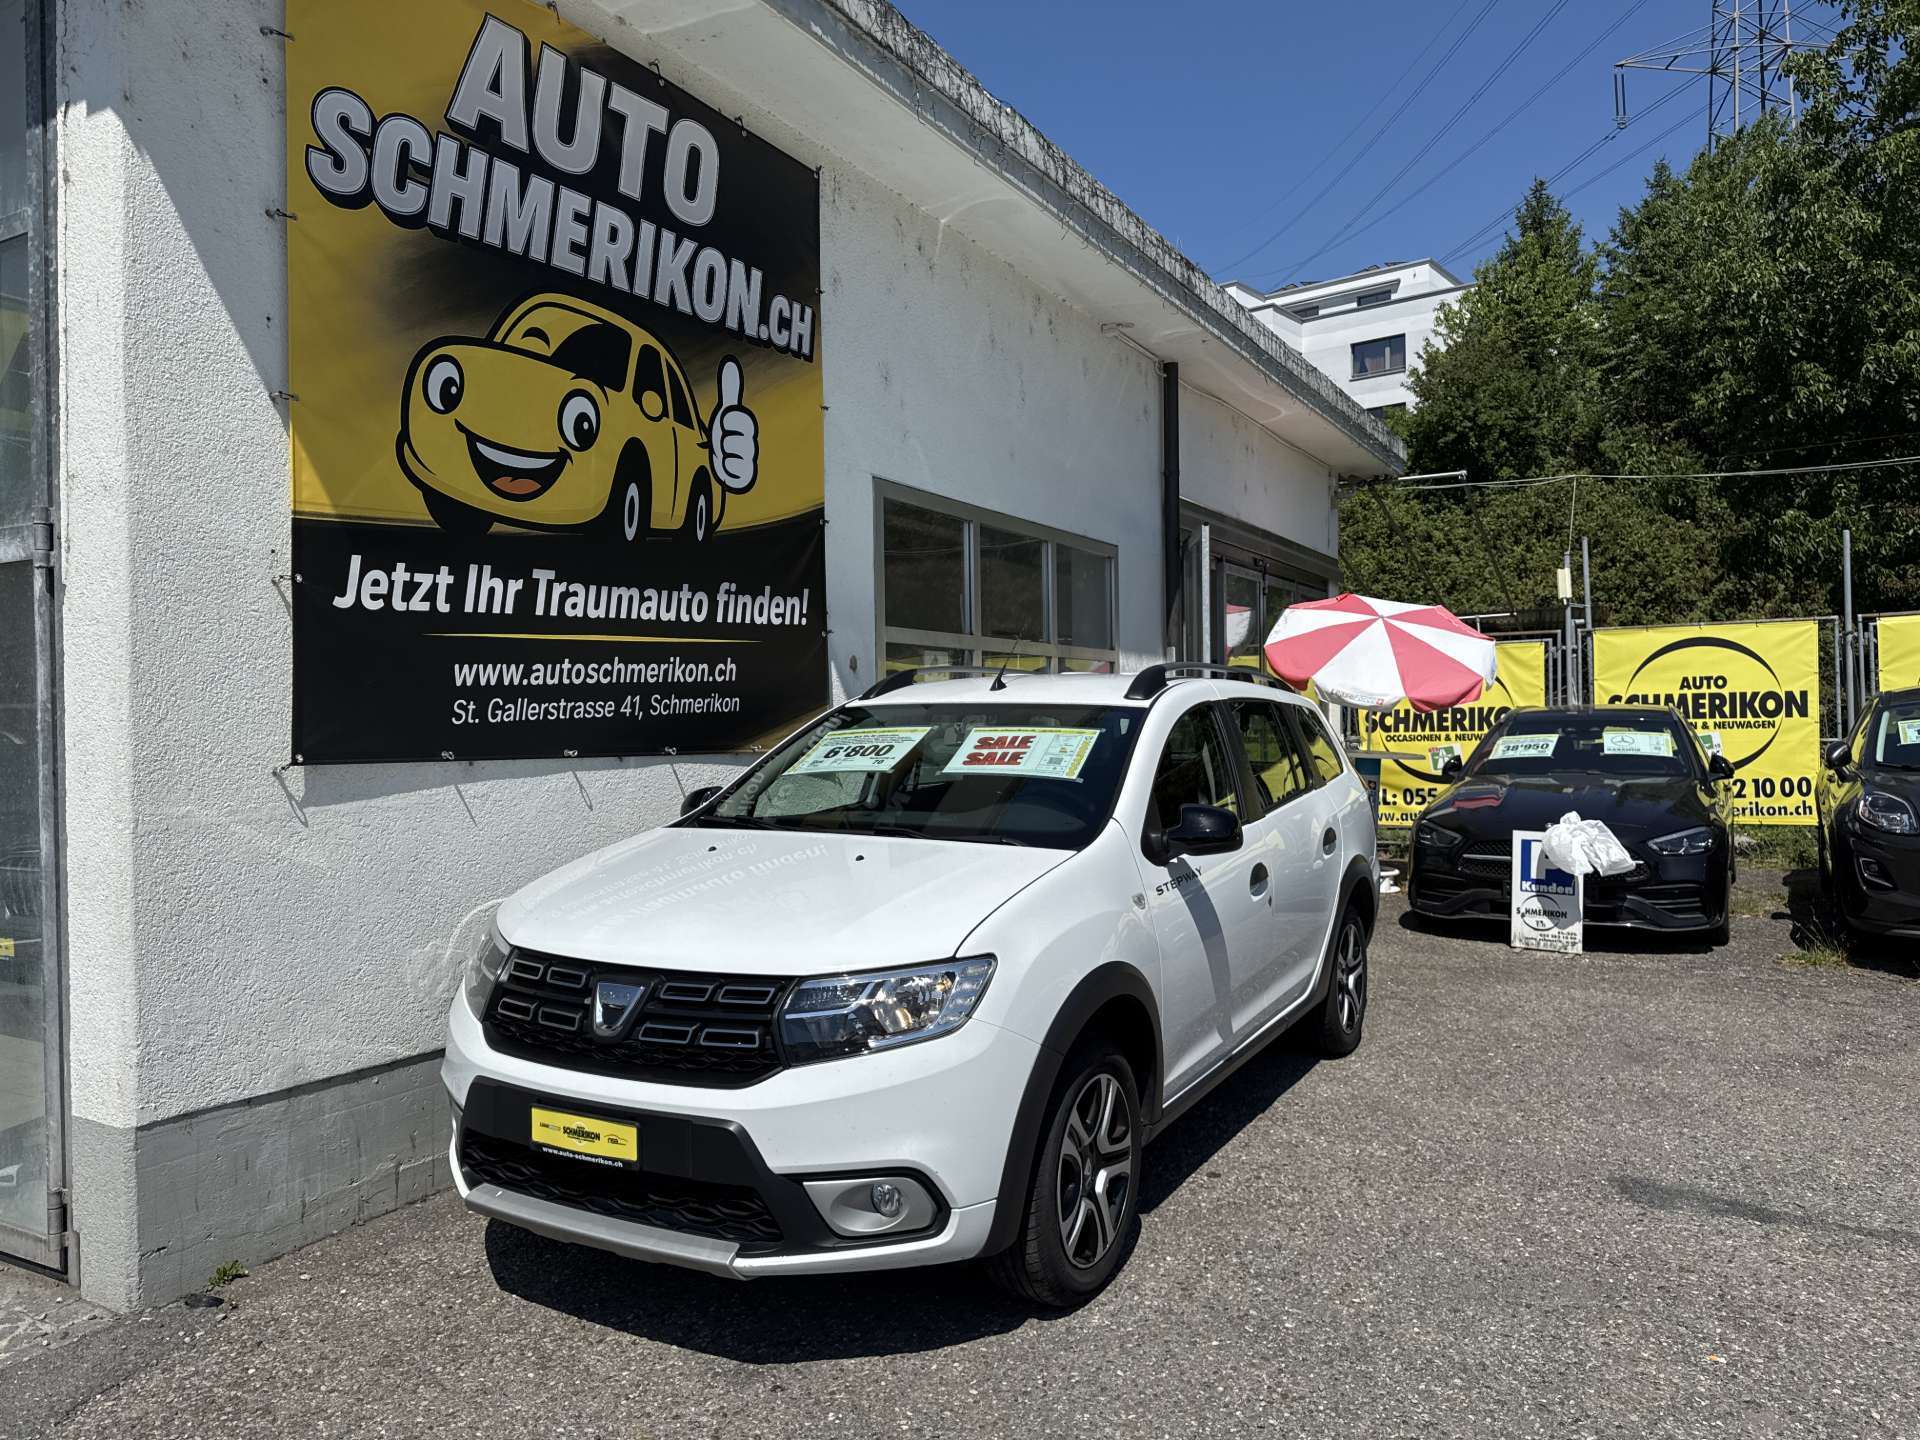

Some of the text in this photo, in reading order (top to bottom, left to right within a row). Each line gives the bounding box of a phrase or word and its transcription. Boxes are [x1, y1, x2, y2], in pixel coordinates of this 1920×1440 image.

[447, 15, 719, 226] AUTO
[307, 89, 815, 356] SCHMERIKON.CH
[332, 554, 809, 627] Jetzt Ihr Traumauto finden!
[453, 656, 737, 687] www.autoschmerikon.ch
[1679, 674, 1727, 691] AUTO
[451, 692, 740, 725] St. Gallerstrasse 41, Schmerikon
[1701, 720, 1710, 729] &
[1713, 719, 1776, 729] NEUWAGEN
[974, 735, 1037, 750] SALE
[1385, 733, 1441, 743] OCCASIONEN
[1444, 733, 1452, 742] &
[824, 744, 896, 759] 6'800
[962, 751, 1028, 766] SALE
[1751, 777, 1775, 798] 10
[1780, 776, 1812, 798] 00
[1155, 866, 1203, 896] STEPWAY
[1521, 880, 1575, 895] Kunden
[1516, 907, 1567, 919] SHMERIKON
[543, 1147, 623, 1166] www.auto-schmerikon.ch
